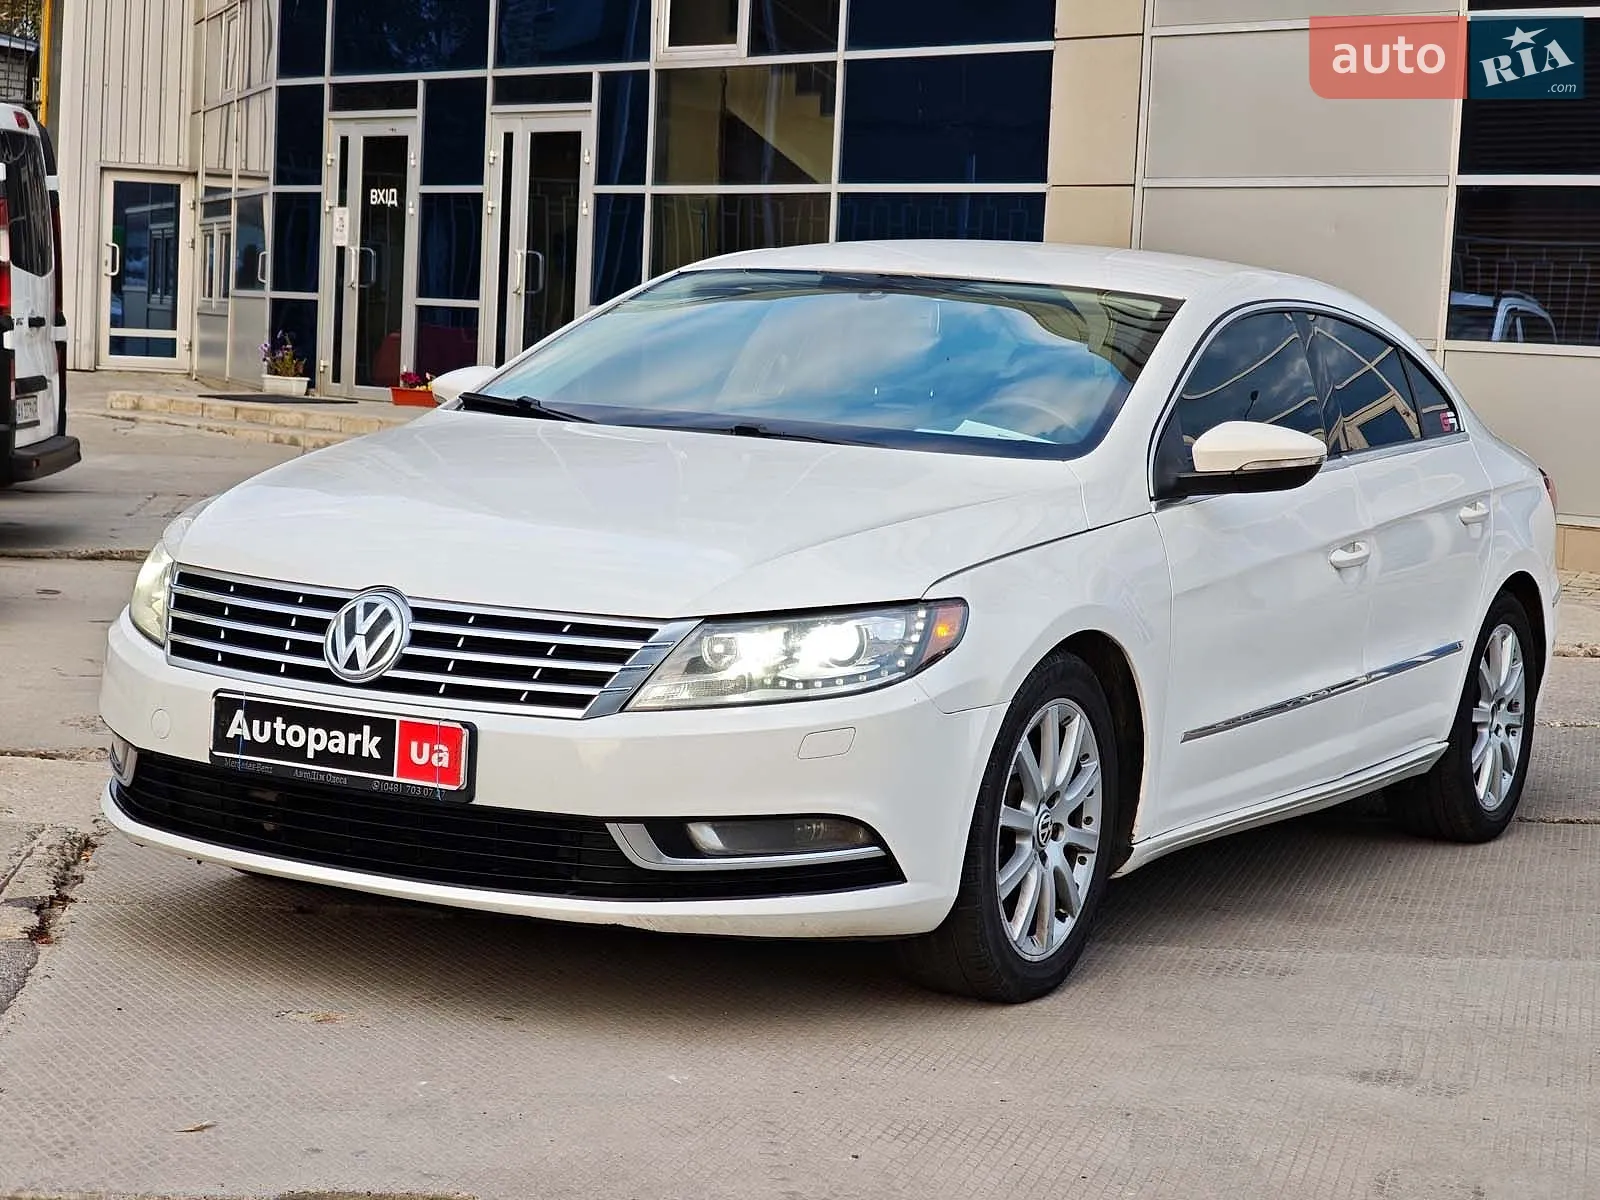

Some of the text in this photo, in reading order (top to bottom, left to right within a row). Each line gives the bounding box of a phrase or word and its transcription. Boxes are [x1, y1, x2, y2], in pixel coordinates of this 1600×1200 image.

[369, 187, 398, 208] ВХІД
[225, 709, 450, 769] Autopark ua
[406, 784, 421, 795] 703
